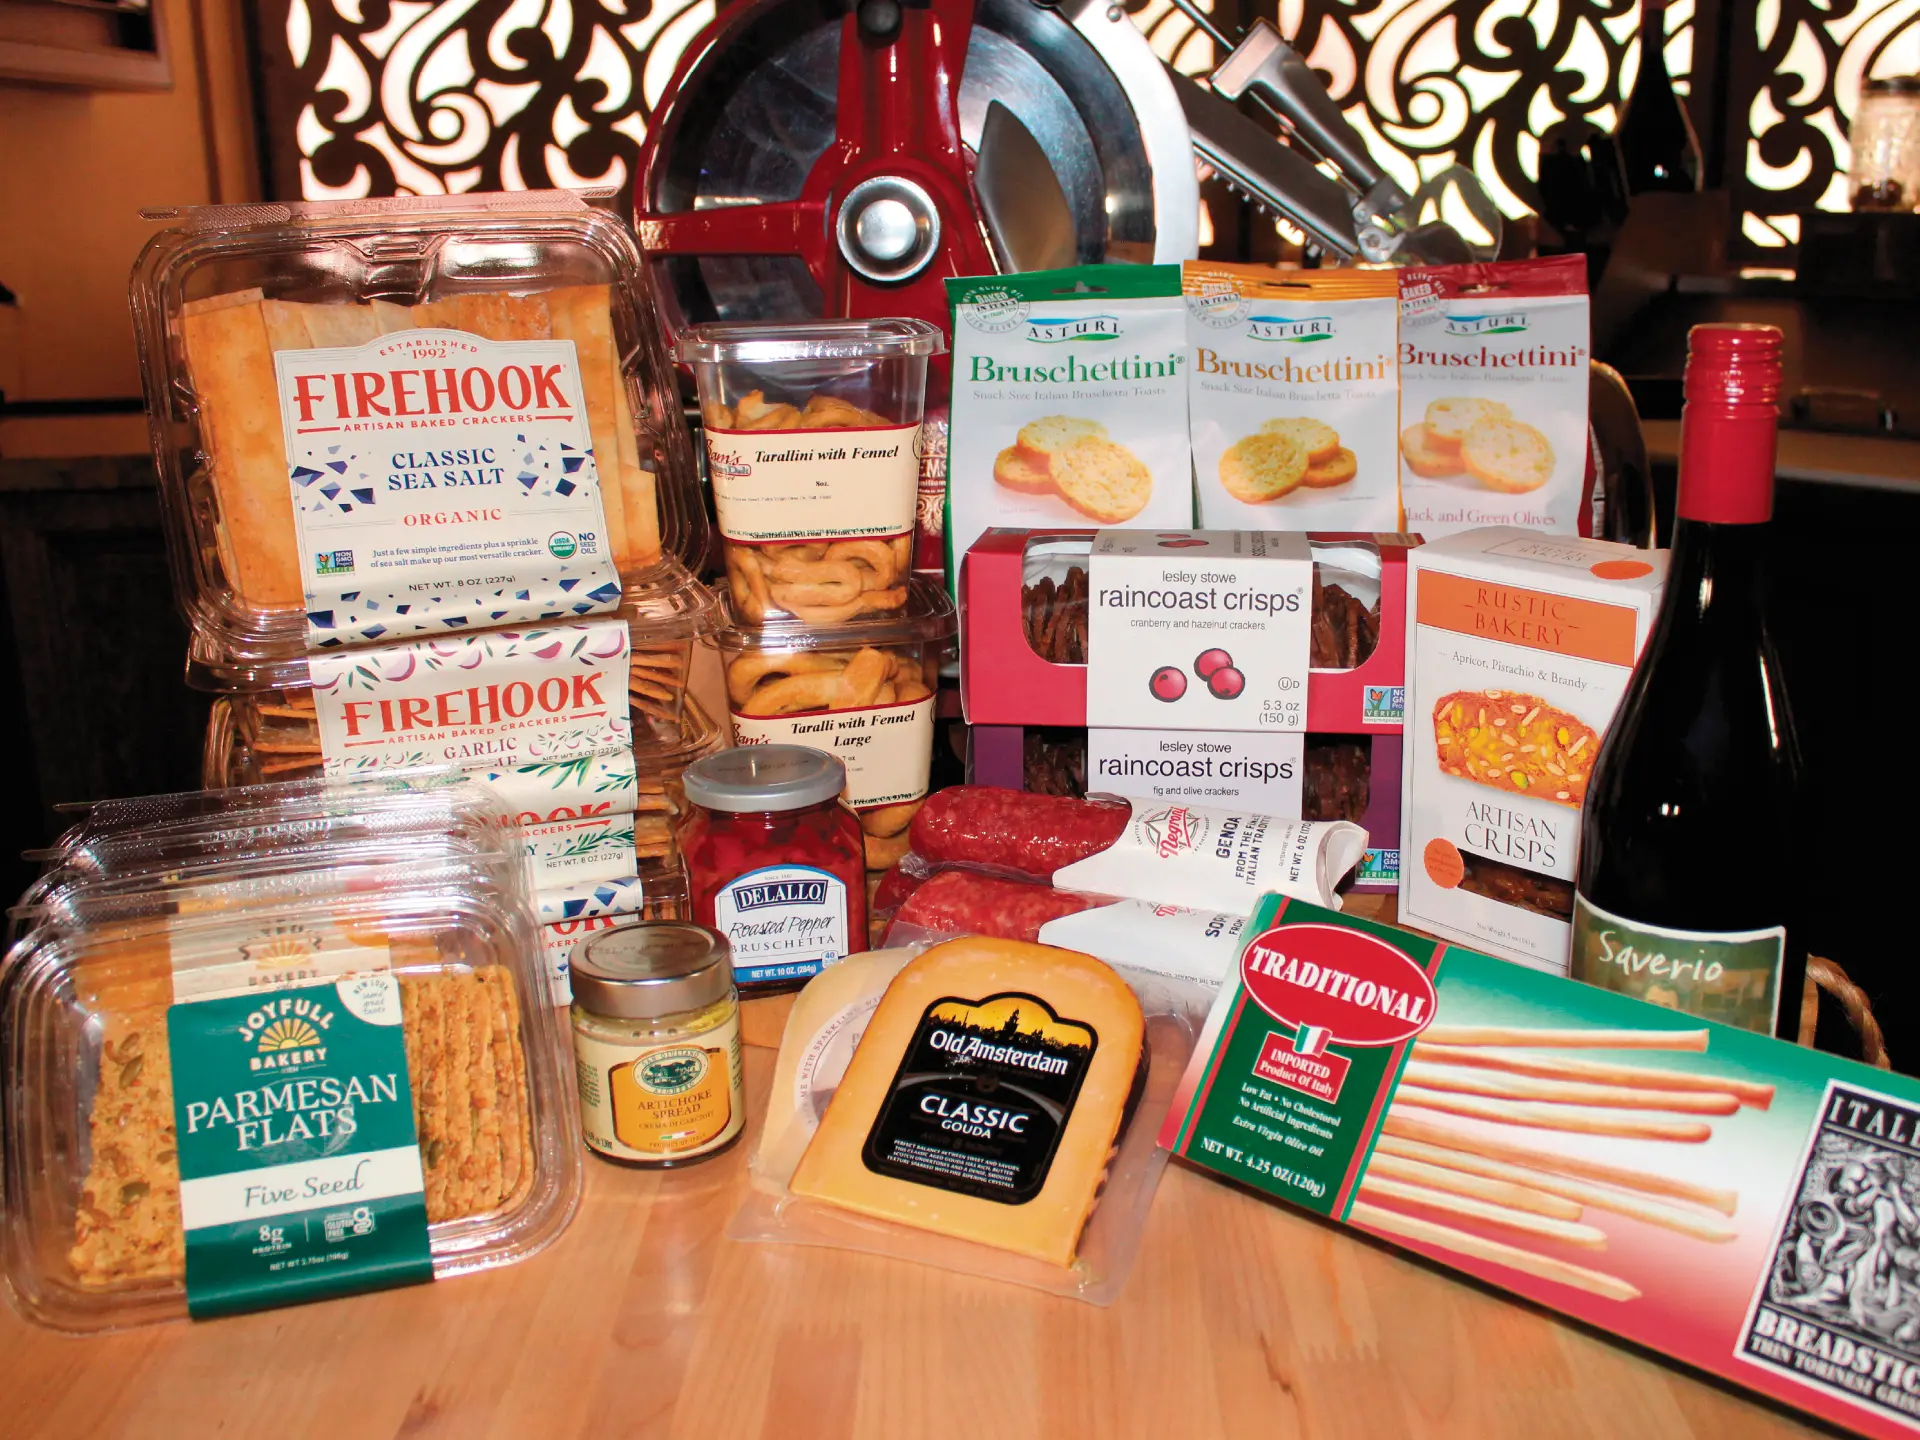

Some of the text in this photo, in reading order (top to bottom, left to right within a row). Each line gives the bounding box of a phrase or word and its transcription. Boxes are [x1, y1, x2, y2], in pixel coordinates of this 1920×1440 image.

[975, 292, 1008, 303] BAKED
[990, 300, 1017, 309] ITALY
[1028, 319, 1119, 339] ASTURI
[1249, 321, 1334, 337] ASTURI
[1446, 317, 1527, 332] ASTURI
[379, 340, 479, 356] ESTABLISHED
[412, 348, 447, 359] 1992
[293, 364, 571, 422] FIREHOOK
[973, 387, 1166, 400] Snack Size Italian Bruschetta Toasts
[344, 414, 533, 432] ARTISAN BAKED CRACKERS
[392, 448, 496, 468] CLASSIC
[706, 439, 741, 466] Sam's
[755, 446, 899, 463] Tarallini with Fennel
[389, 468, 504, 490] SEA SALT
[403, 508, 502, 527] ORGANIC
[1438, 509, 1464, 523] and
[1467, 511, 1510, 524] Green
[1513, 510, 1556, 526] Olives
[373, 549, 389, 558] Just
[411, 545, 437, 555] simple
[438, 542, 482, 553] ingredients
[483, 541, 499, 551] plus
[507, 538, 538, 549] sprinkle
[579, 533, 595, 541] NO
[394, 558, 408, 566] salt
[410, 556, 431, 564] make
[433, 556, 442, 565] up
[445, 554, 458, 562] our
[459, 553, 478, 561] most
[479, 550, 512, 560] versatile
[513, 548, 544, 558] cracker.
[485, 576, 516, 584] (227g)
[1162, 570, 1237, 585] lesley stowe
[1099, 586, 1218, 610] raincoast
[1477, 588, 1564, 620] RUSTIC
[1130, 618, 1266, 631] cranberry and hazelnut crackers
[1475, 613, 1563, 645] BAKERY
[1451, 650, 1588, 692] Apricot, Pistachio & Brandy
[341, 671, 606, 736] FIREHOOK
[1263, 700, 1300, 712] 5.3 oz
[388, 715, 567, 745] ARTISAN BAKED CRACKERS
[791, 710, 915, 734] Taralli with Fennel
[1258, 712, 1300, 726] (150 g)
[444, 737, 518, 760] GARLIC
[834, 735, 872, 747] Large
[1159, 740, 1232, 756] lesley stowe
[1099, 755, 1213, 778] raincoast
[1153, 785, 1240, 798] fig and olive crackers
[1160, 806, 1189, 858] Negroni
[1465, 800, 1558, 842] ARTISAN
[1216, 817, 1242, 859] GENOA
[1298, 835, 1308, 843] OZ
[1464, 823, 1557, 869] CRISPS
[1236, 831, 1253, 878] FROM THE
[1292, 852, 1304, 865] WT.
[1246, 848, 1260, 886] ITALIAN
[1289, 867, 1301, 882] NET
[739, 884, 821, 908] DELALLO
[728, 916, 835, 938] Roasted Pepper
[732, 935, 835, 953] BRUSCHETTA
[1598, 930, 1725, 983] Saverio
[751, 965, 817, 978] NET WT. 10 OZ. (284g)
[1249, 945, 1426, 1025] TRADITIONAL
[238, 998, 334, 1042] JOYFULL
[250, 1047, 328, 1070] BAKERY
[929, 1029, 1068, 1075] Old Amsterdam
[1270, 1048, 1330, 1079] IMPORTED
[1259, 1061, 1334, 1098] Product Of Italy
[186, 1073, 398, 1134] PARMESAN
[638, 1089, 712, 1110] ARTICHOKE
[1242, 1082, 1292, 1108] Low Fat No
[653, 1104, 701, 1119] SPREAD
[920, 1094, 1029, 1134] CLASSIC
[1239, 1096, 1333, 1139] No Artificial Ingredients
[236, 1105, 358, 1152] FLATS
[940, 1119, 992, 1140] GOUDA
[1232, 1115, 1326, 1160] Extra Virgin Olive Oil
[1201, 1135, 1225, 1155] NET
[1225, 1146, 1244, 1164] WT.
[1245, 1152, 1270, 1173] 4.25
[244, 1159, 371, 1208] Five Seed
[259, 1224, 284, 1245] 8g
[252, 1243, 292, 1254] PROTEIN
[1751, 1335, 1793, 1363] THIN
